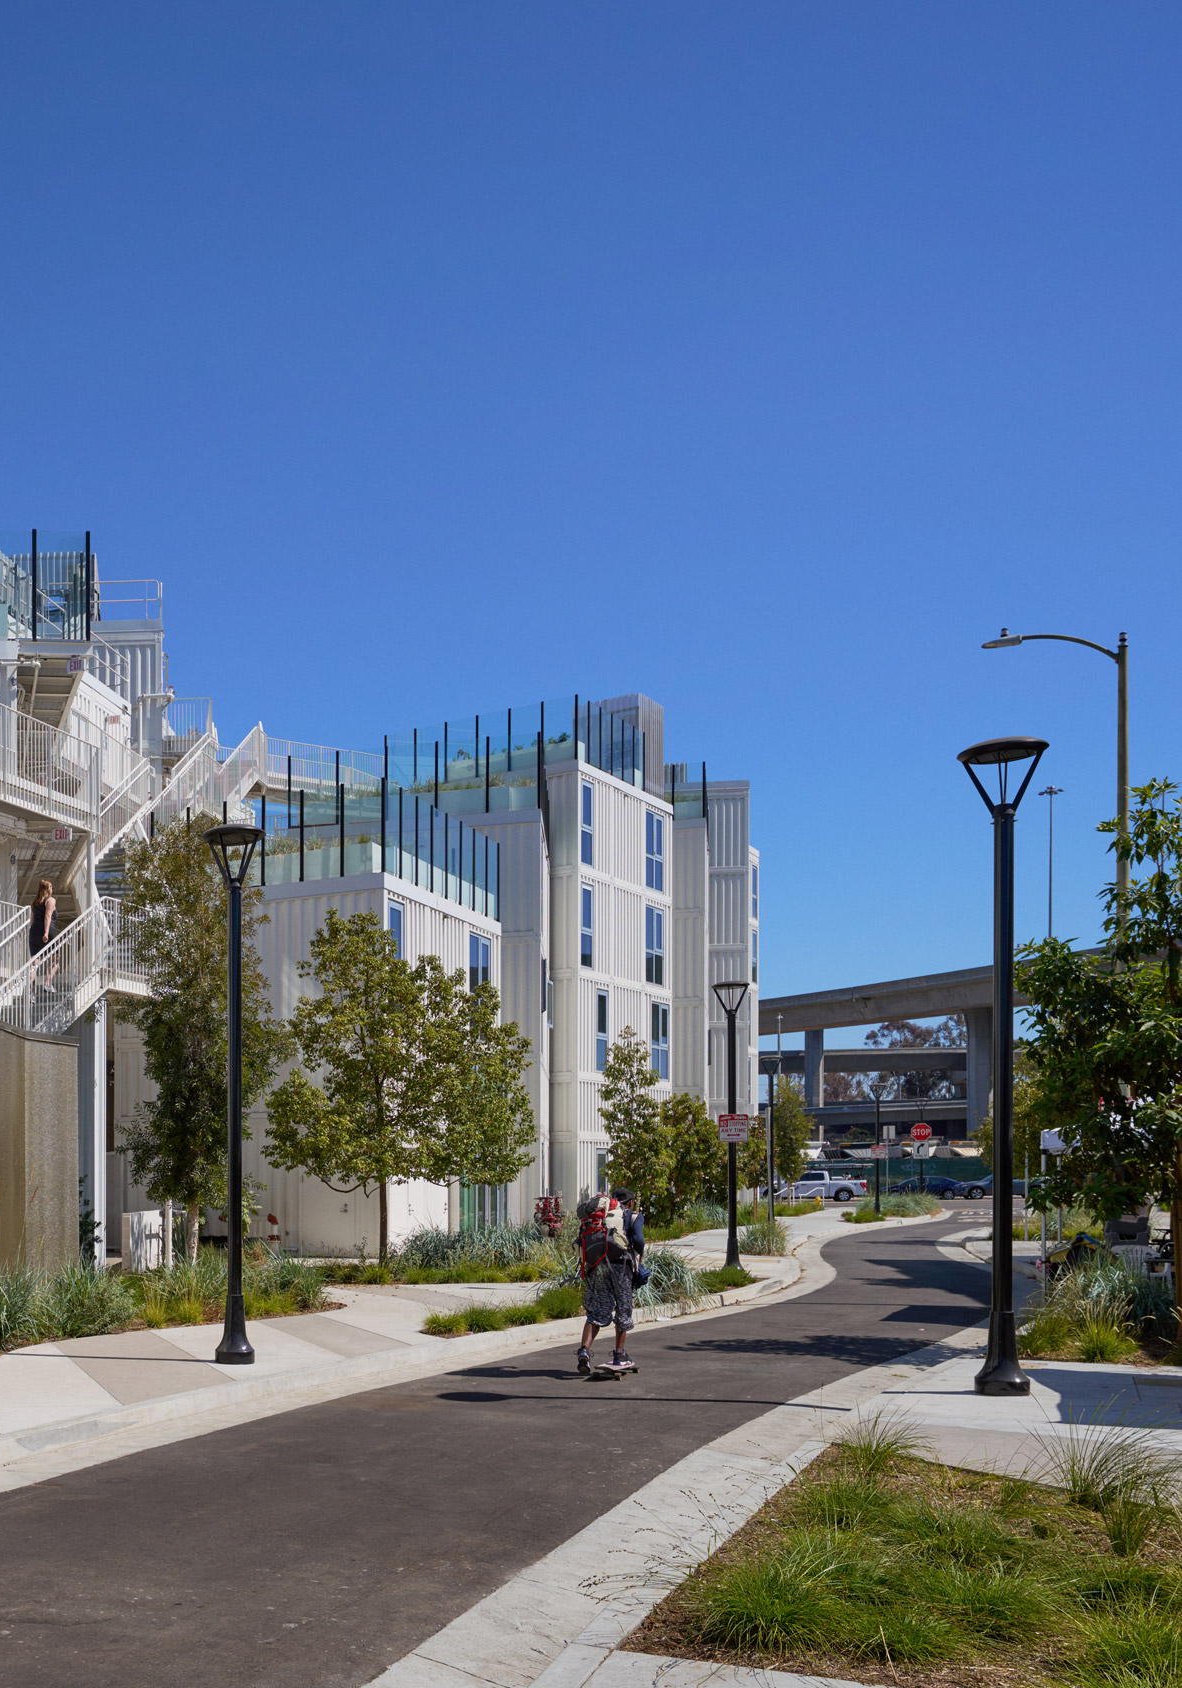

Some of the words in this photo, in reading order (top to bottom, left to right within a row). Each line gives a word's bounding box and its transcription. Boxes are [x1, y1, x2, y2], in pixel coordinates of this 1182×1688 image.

[69, 660, 82, 671] EXIT
[54, 829, 68, 840] EXIT
[912, 1128, 931, 1136] STOP
